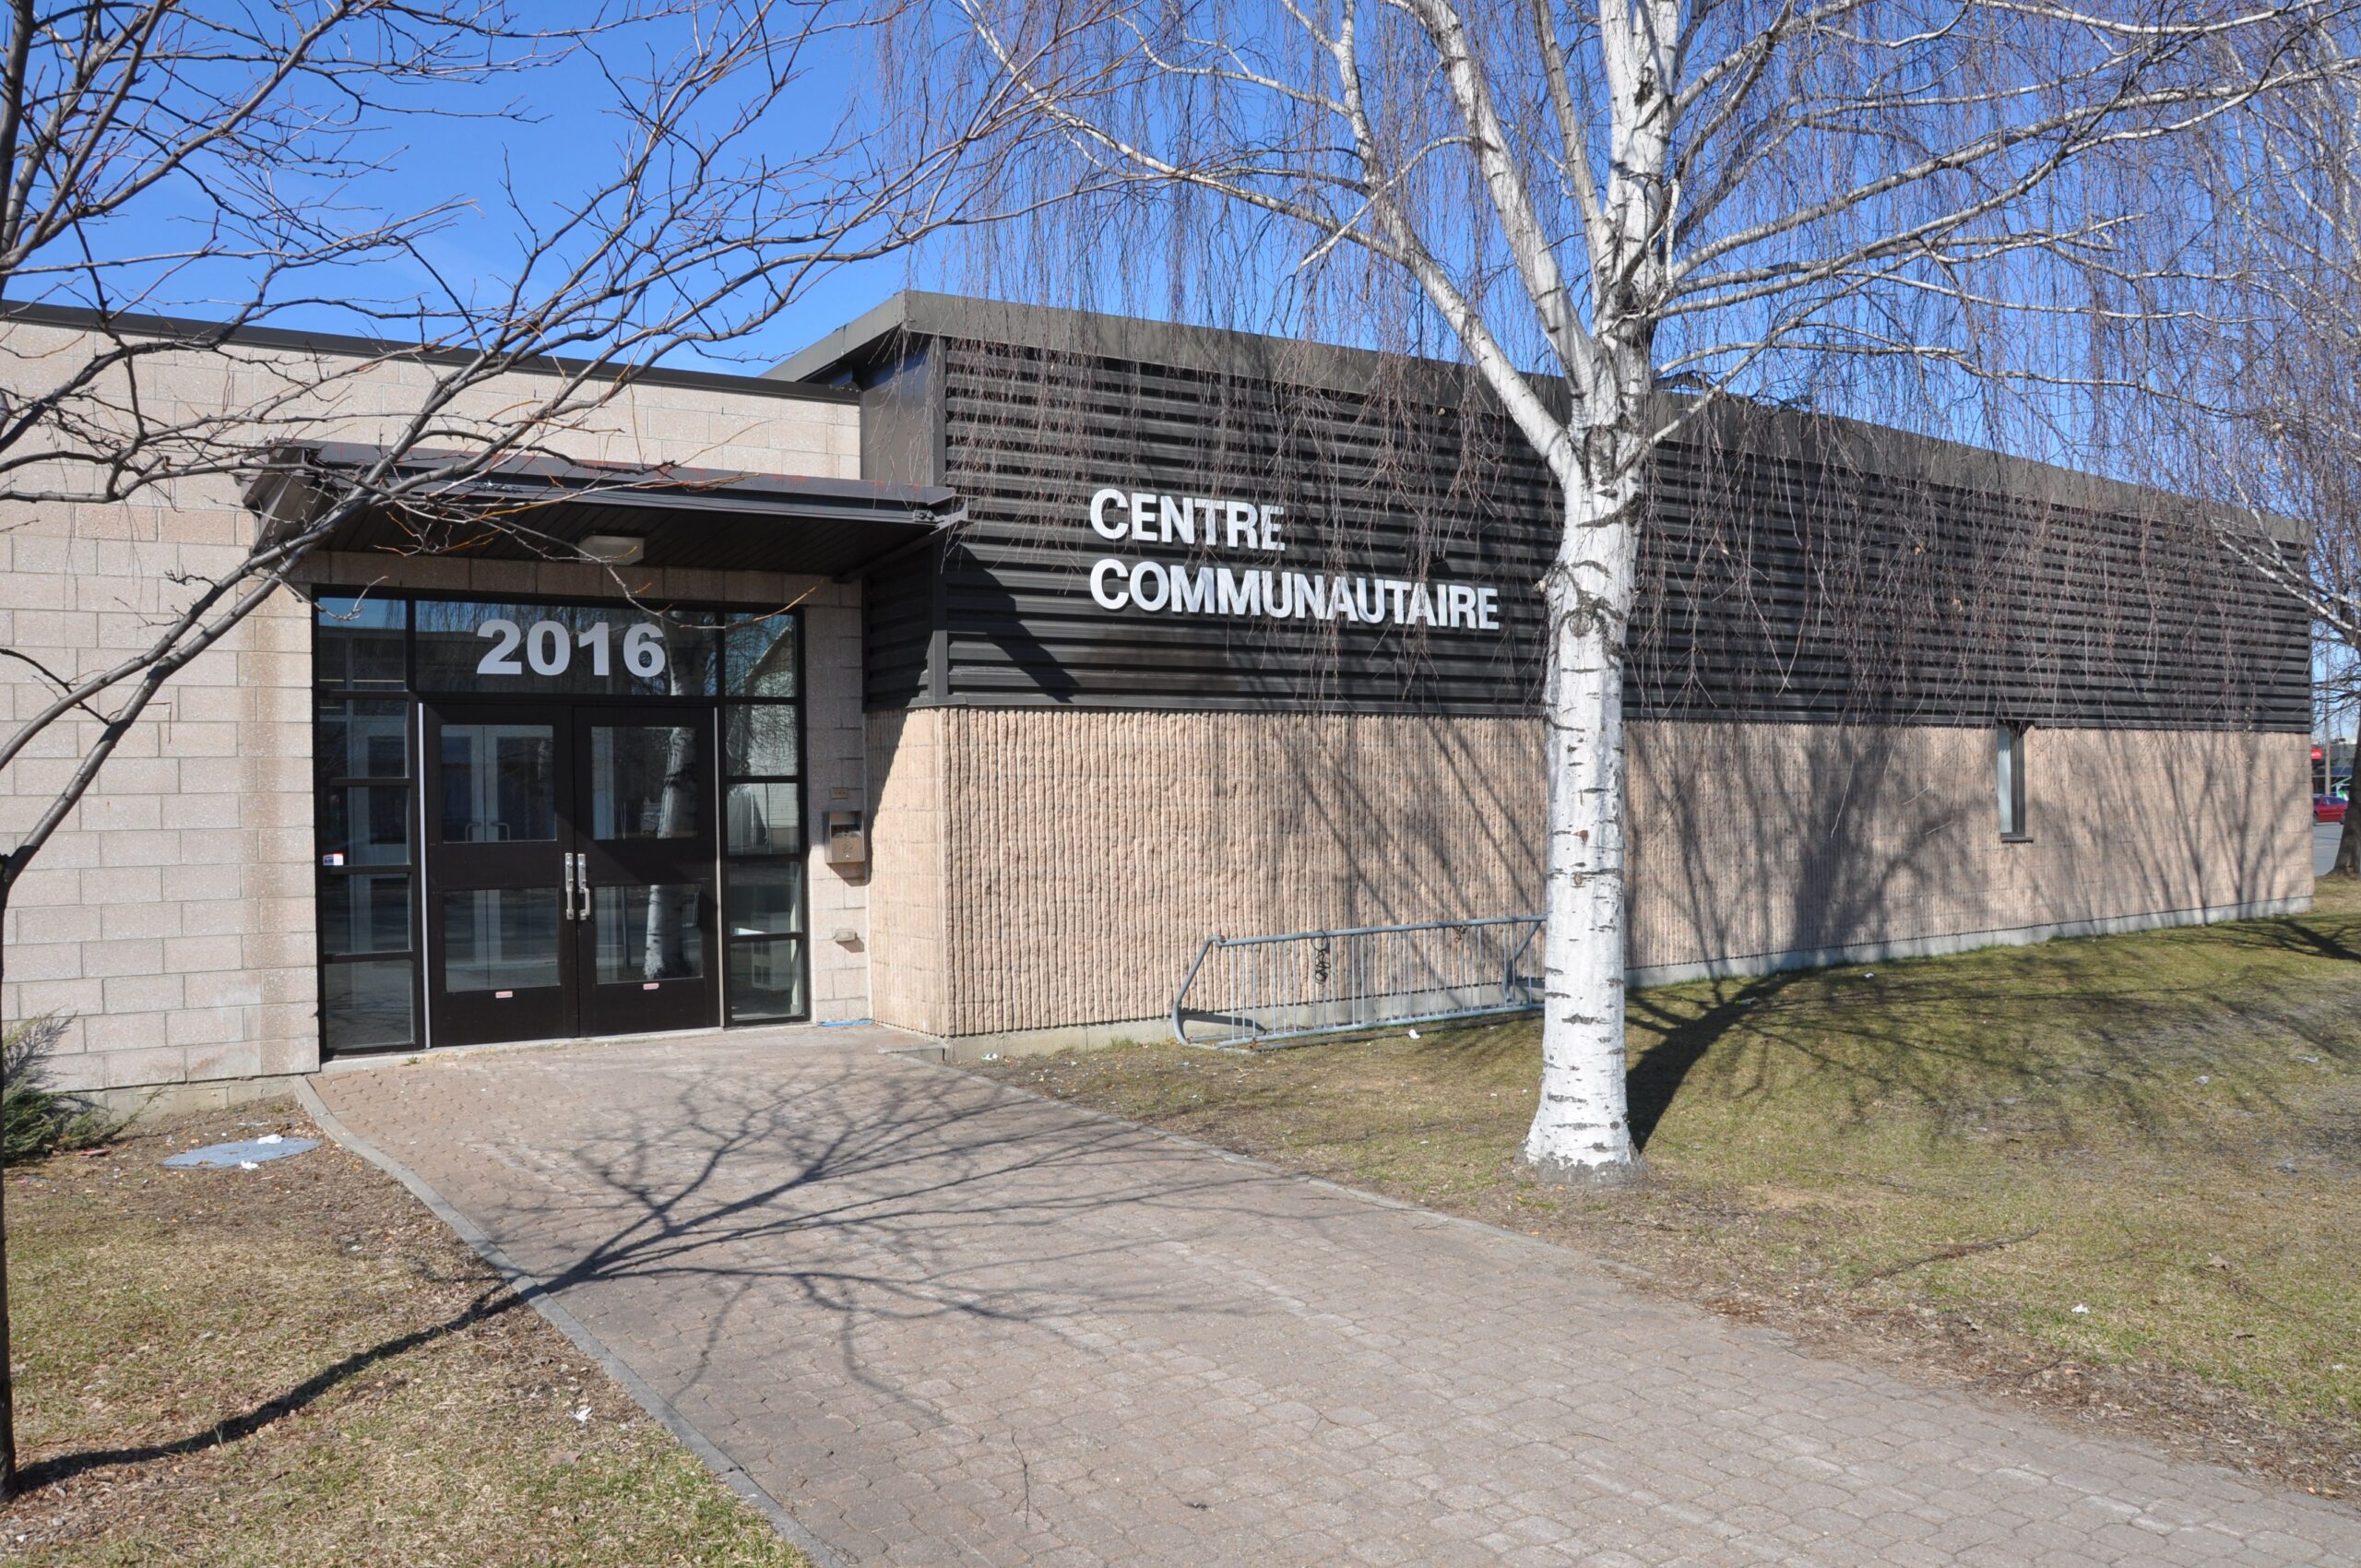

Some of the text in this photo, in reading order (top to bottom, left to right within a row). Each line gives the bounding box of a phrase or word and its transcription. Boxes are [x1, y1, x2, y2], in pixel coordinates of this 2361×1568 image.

[1089, 488, 1286, 552] CENTRE
[1089, 558, 1501, 631] COMMUNAUTAIRE
[476, 619, 666, 678] 2016
